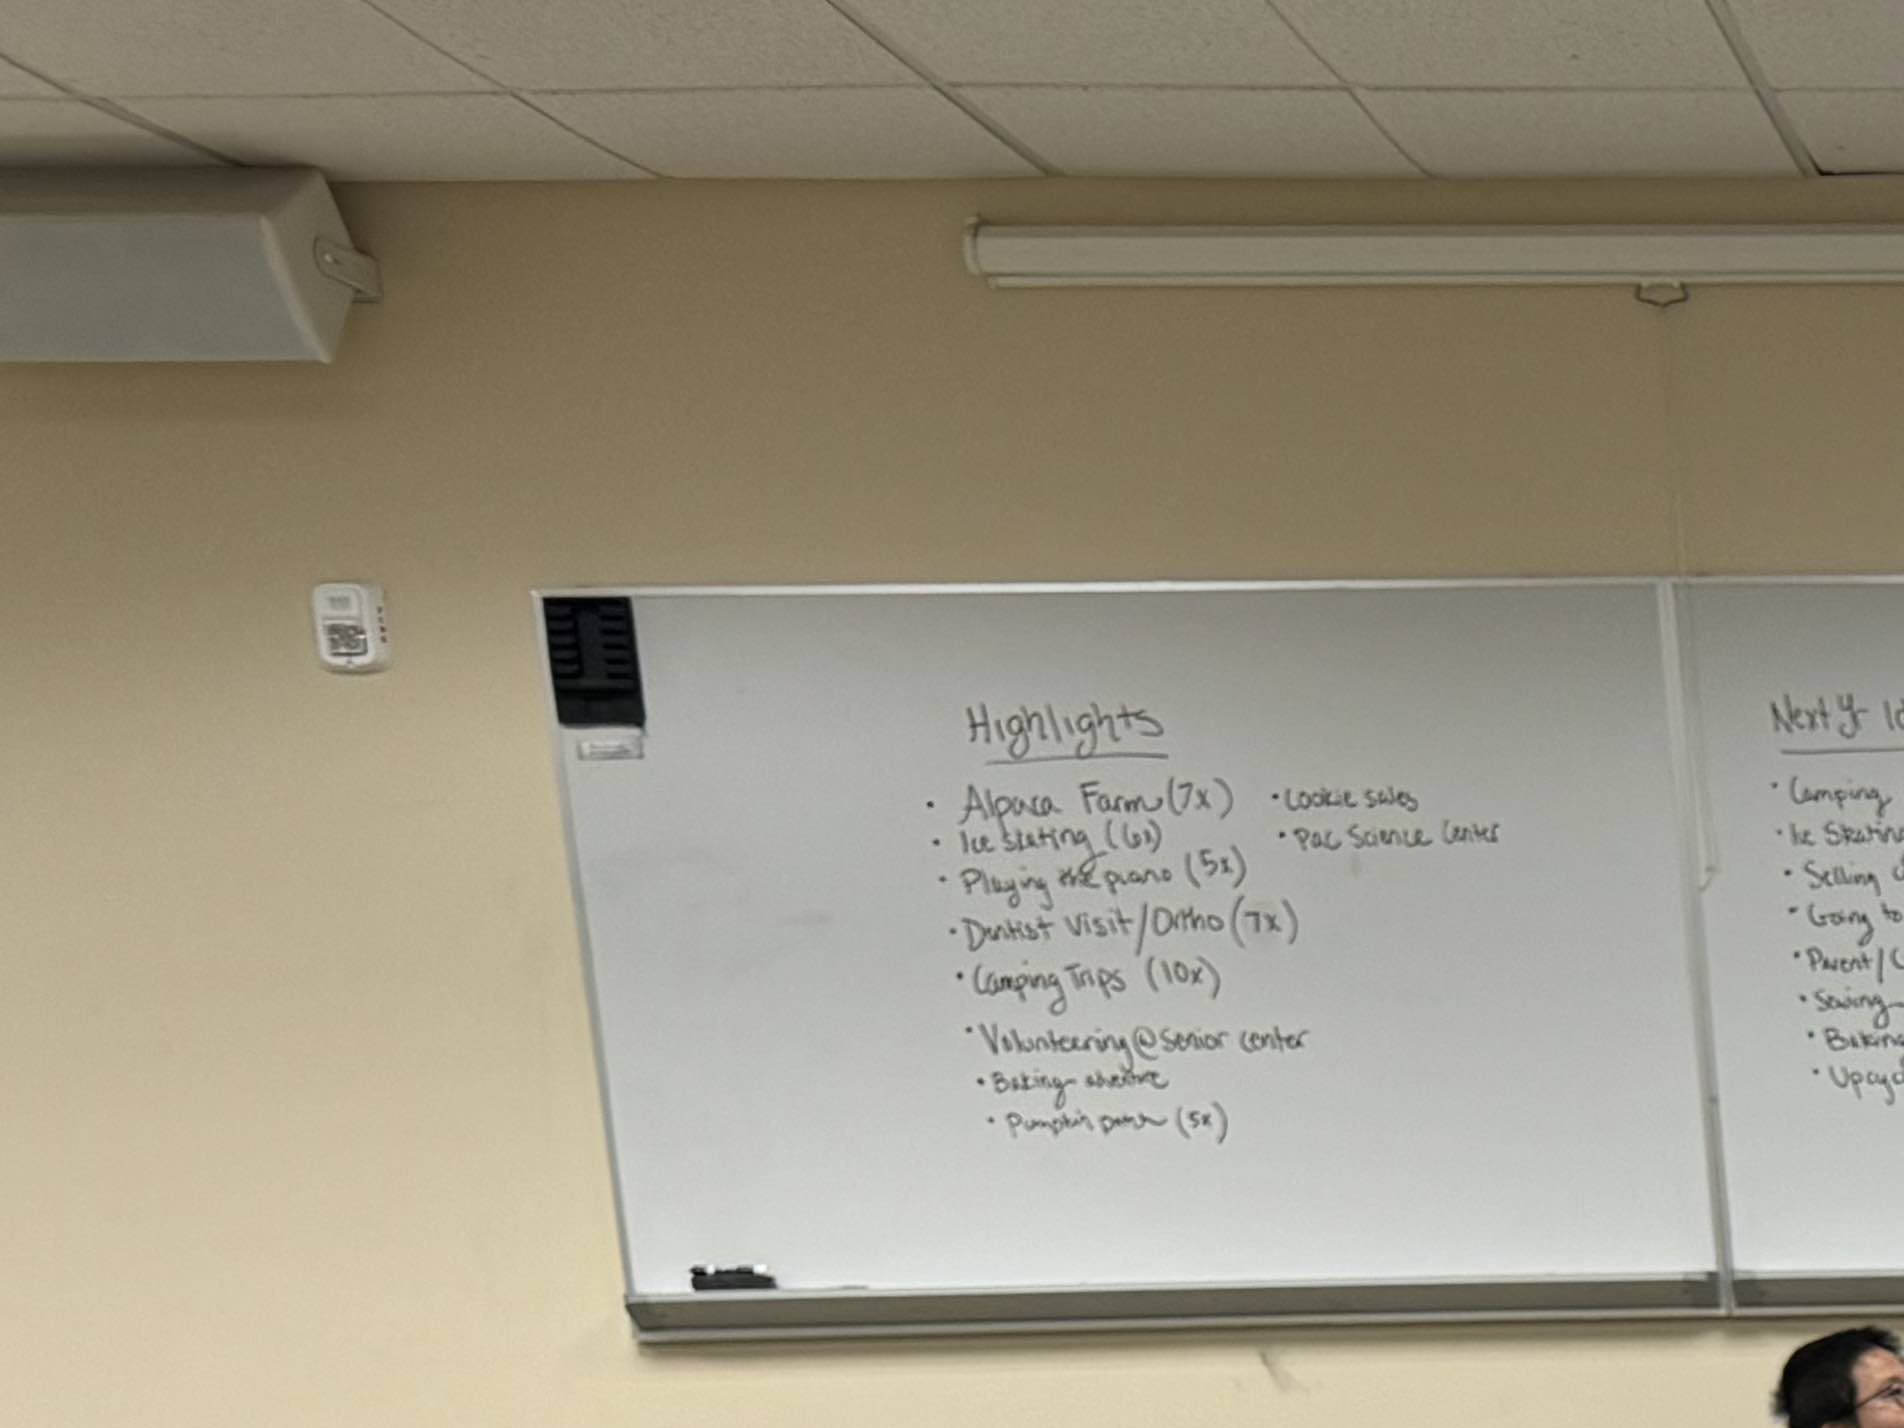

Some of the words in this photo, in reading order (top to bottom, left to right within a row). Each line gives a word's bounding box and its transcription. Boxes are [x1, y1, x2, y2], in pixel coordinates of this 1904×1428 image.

[966, 702, 1164, 760] Highlights
[1769, 692, 1831, 734] Next
[958, 784, 1063, 830] Alpaca
[1079, 780, 1163, 815] Farm
[1166, 776, 1235, 821] (7x)
[1788, 774, 1892, 820] Camping
[960, 829, 994, 853] Ice
[1347, 823, 1433, 849] Science
[959, 867, 1054, 911] Playing
[1057, 864, 1100, 890] the
[1102, 866, 1172, 895] piano
[1184, 845, 1247, 890] (5x)
[1803, 858, 1883, 898] Selling
[961, 915, 1054, 952] Dentist
[1230, 894, 1300, 950] (7x)
[1807, 904, 1875, 947] Going
[1881, 901, 1904, 923] to
[971, 963, 1068, 1017] Camping
[1064, 962, 1127, 1000] Trips
[1145, 954, 1222, 1001] (10x)
[1176, 1100, 1228, 1144] (5x)
